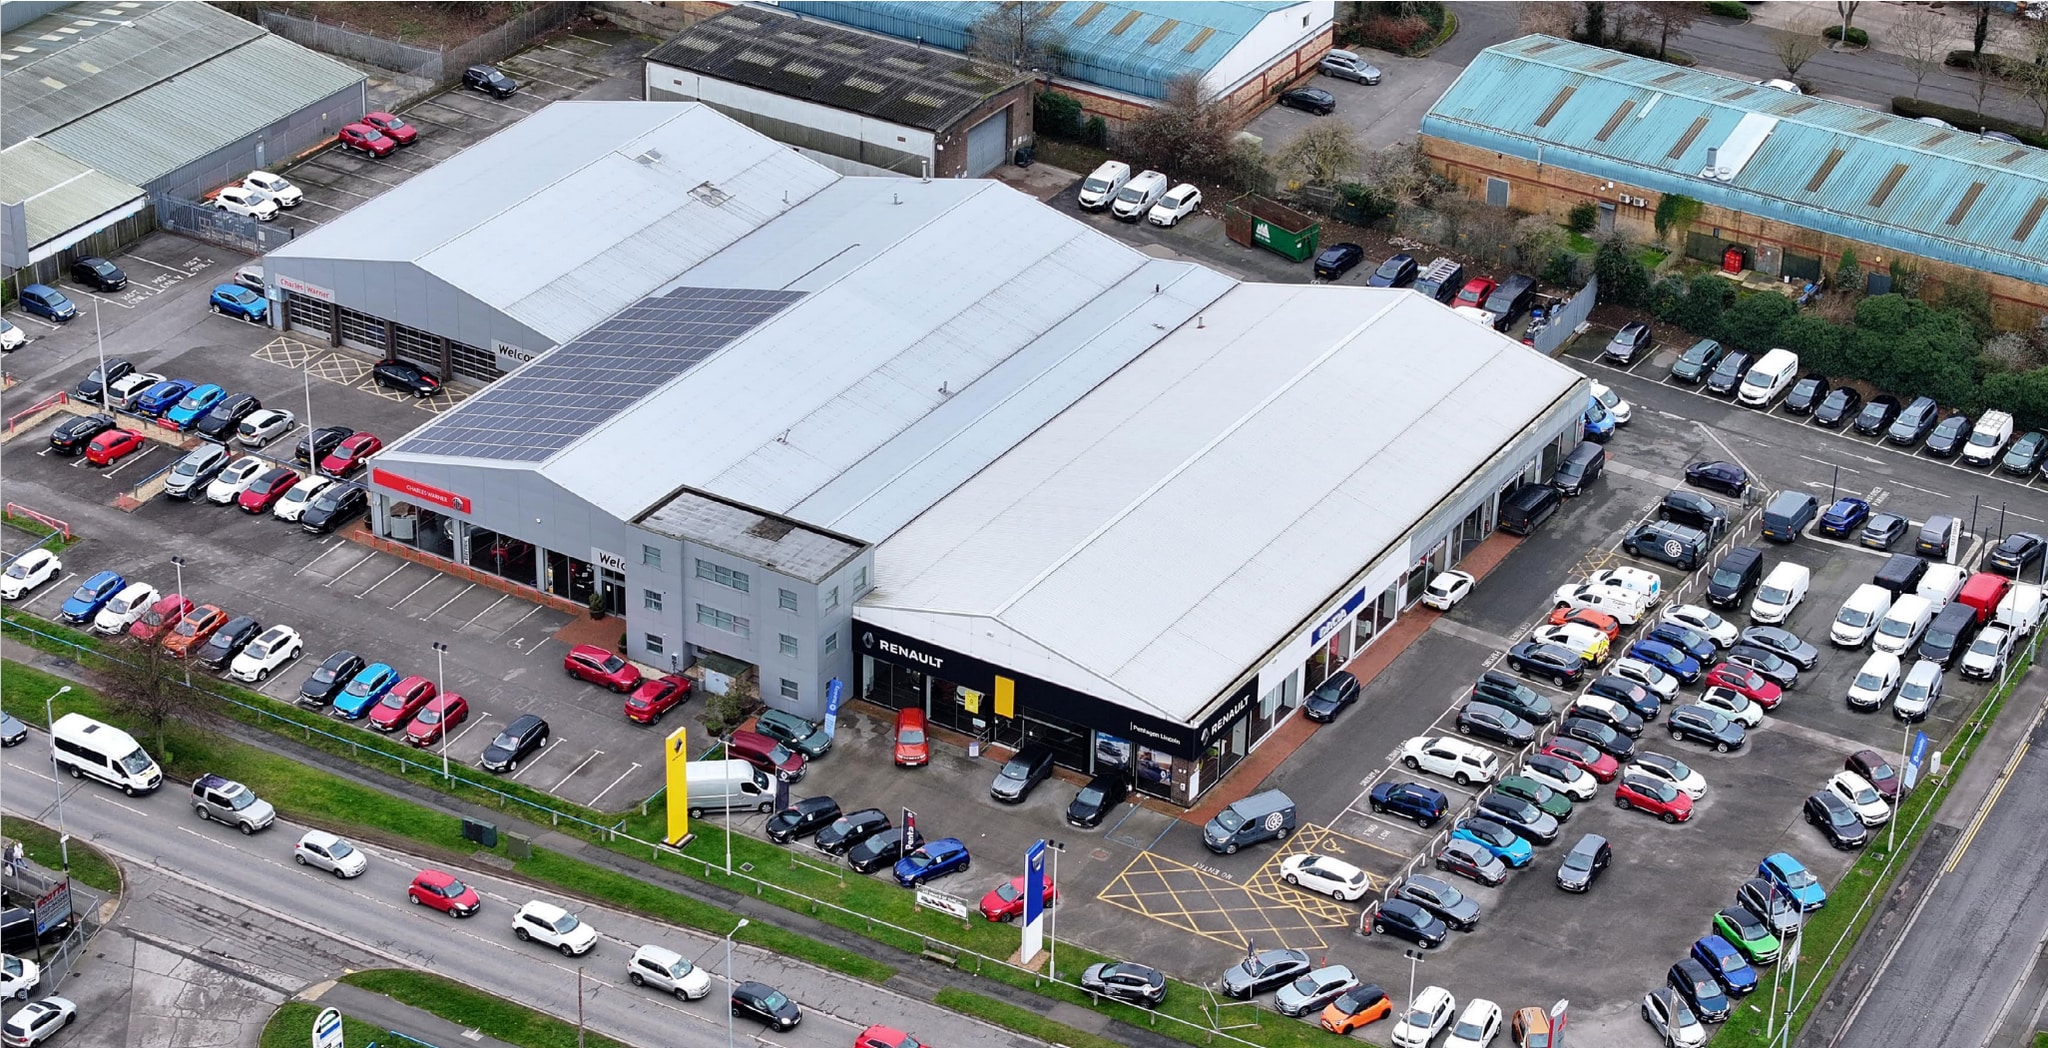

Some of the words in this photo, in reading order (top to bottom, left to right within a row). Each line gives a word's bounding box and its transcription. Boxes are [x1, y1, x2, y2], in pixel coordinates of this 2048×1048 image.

[280, 278, 304, 291] Charles
[306, 286, 330, 299] Warner
[879, 639, 944, 669] RENAULT
[1211, 694, 1251, 736] RENAULT
[1133, 724, 1160, 739] Pentagon
[1160, 733, 1181, 745] Lincoln
